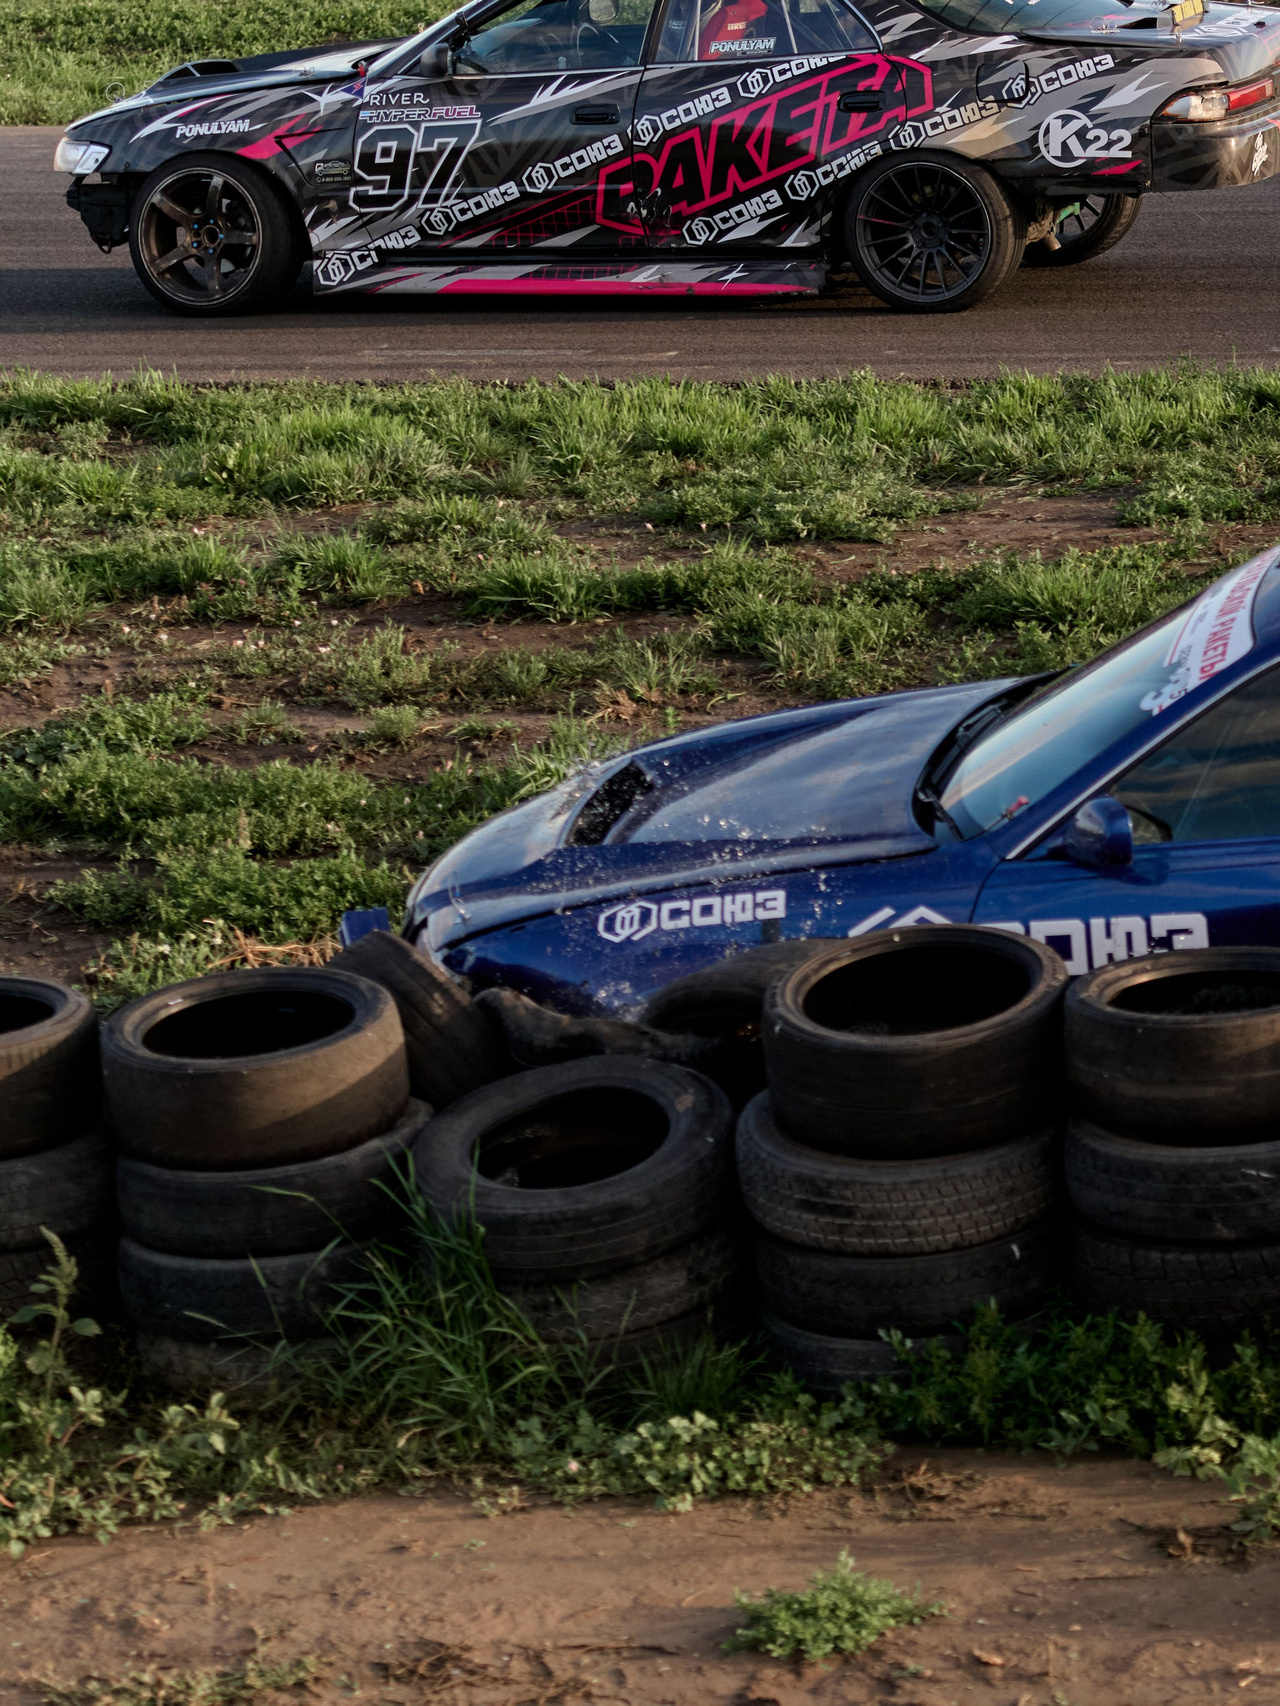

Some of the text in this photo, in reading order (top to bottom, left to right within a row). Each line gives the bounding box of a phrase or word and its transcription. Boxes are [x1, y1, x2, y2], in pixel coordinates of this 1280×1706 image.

[710, 38, 775, 54] PONULYAM
[1040, 53, 1115, 93] СОЮЗ
[370, 93, 430, 106] RIVER
[660, 86, 732, 131] СОЮЗ
[925, 95, 1001, 137] СОЮЗ
[175, 119, 251, 138] PONULYAM
[349, 119, 482, 212] 97
[556, 134, 624, 178] СОЮЗ
[815, 140, 883, 186] СОЮЗ
[453, 181, 521, 223] СОЮЗ
[714, 189, 783, 230] СОЮЗ
[660, 890, 786, 930] СОЮЗ
